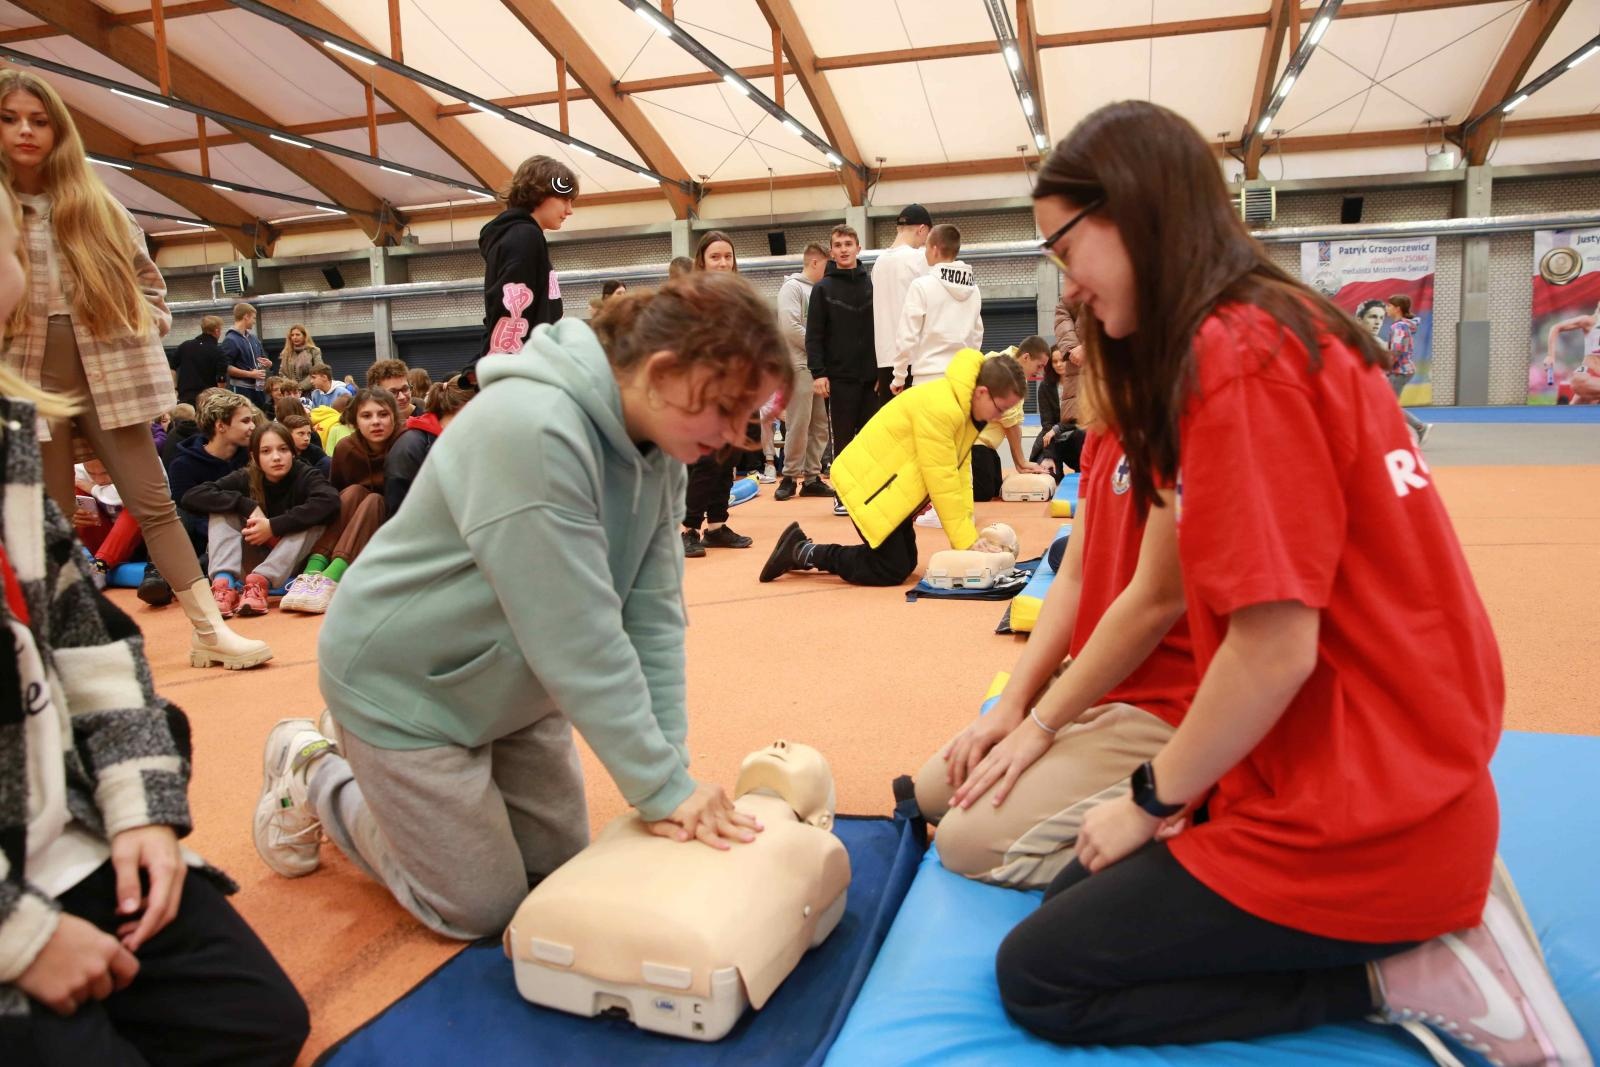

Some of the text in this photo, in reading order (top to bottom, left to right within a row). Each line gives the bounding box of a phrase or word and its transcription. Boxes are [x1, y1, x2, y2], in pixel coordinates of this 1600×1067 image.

[1339, 243, 1430, 256] Patryk Grzegorzewicz
[941, 268, 966, 286] YORK
